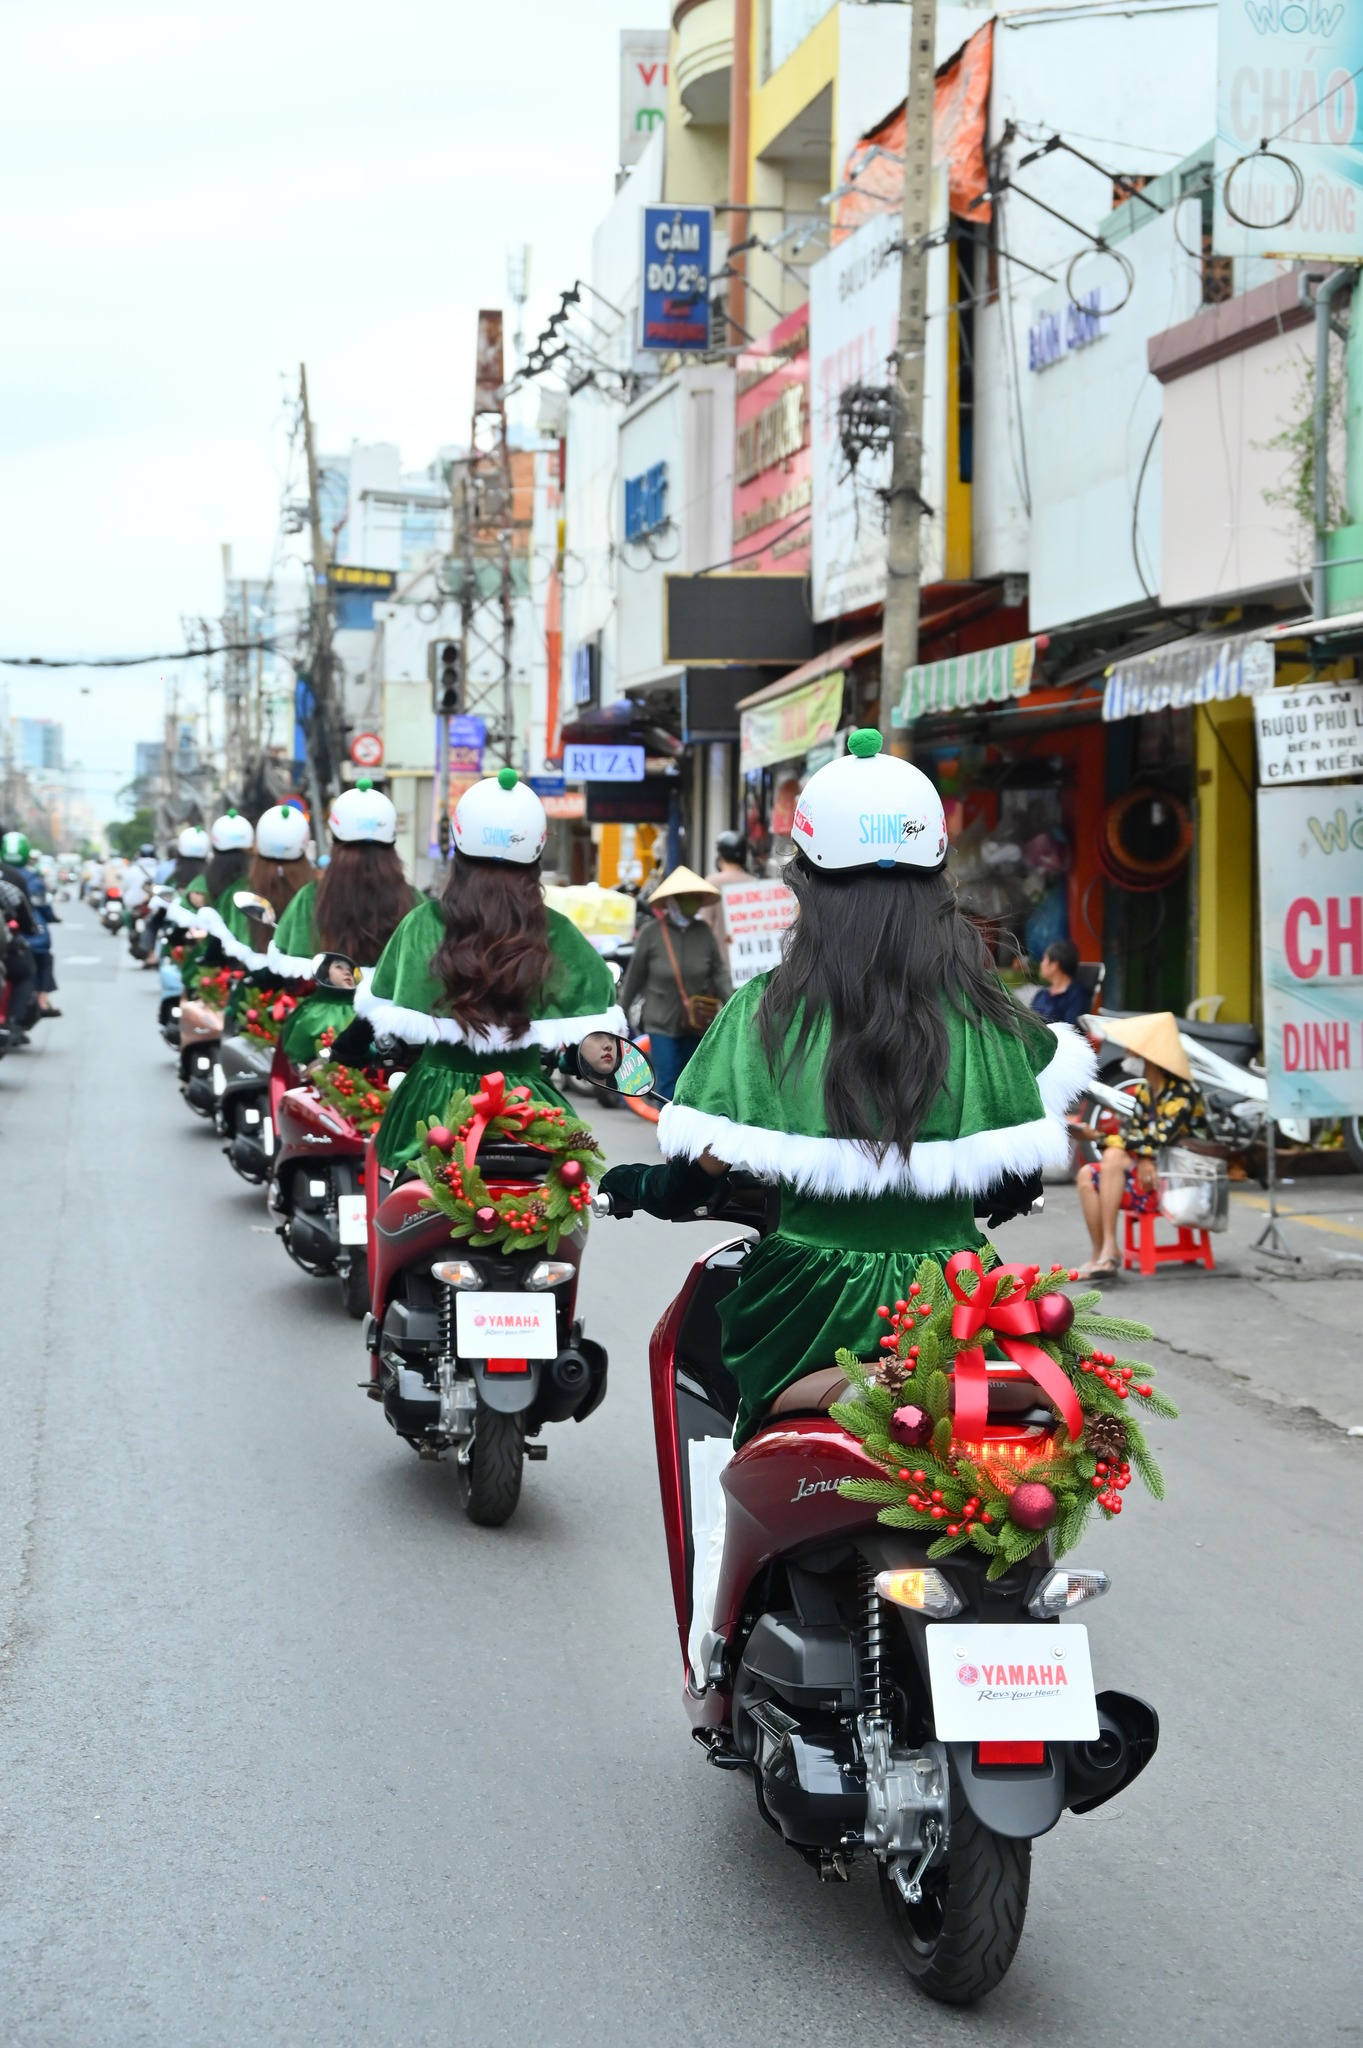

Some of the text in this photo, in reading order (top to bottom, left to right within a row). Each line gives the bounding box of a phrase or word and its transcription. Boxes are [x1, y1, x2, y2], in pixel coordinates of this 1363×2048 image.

[1231, 46, 1357, 145] CHÁO
[572, 752, 637, 774] RUZA
[482, 826, 514, 848] SHINE
[859, 814, 908, 845] SHINE
[1283, 1022, 1350, 1072] DINH
[488, 1315, 540, 1328] YAMAHA
[981, 1664, 1068, 1686] YAMAHA
[976, 1688, 1060, 1702] Revs Your Heart
